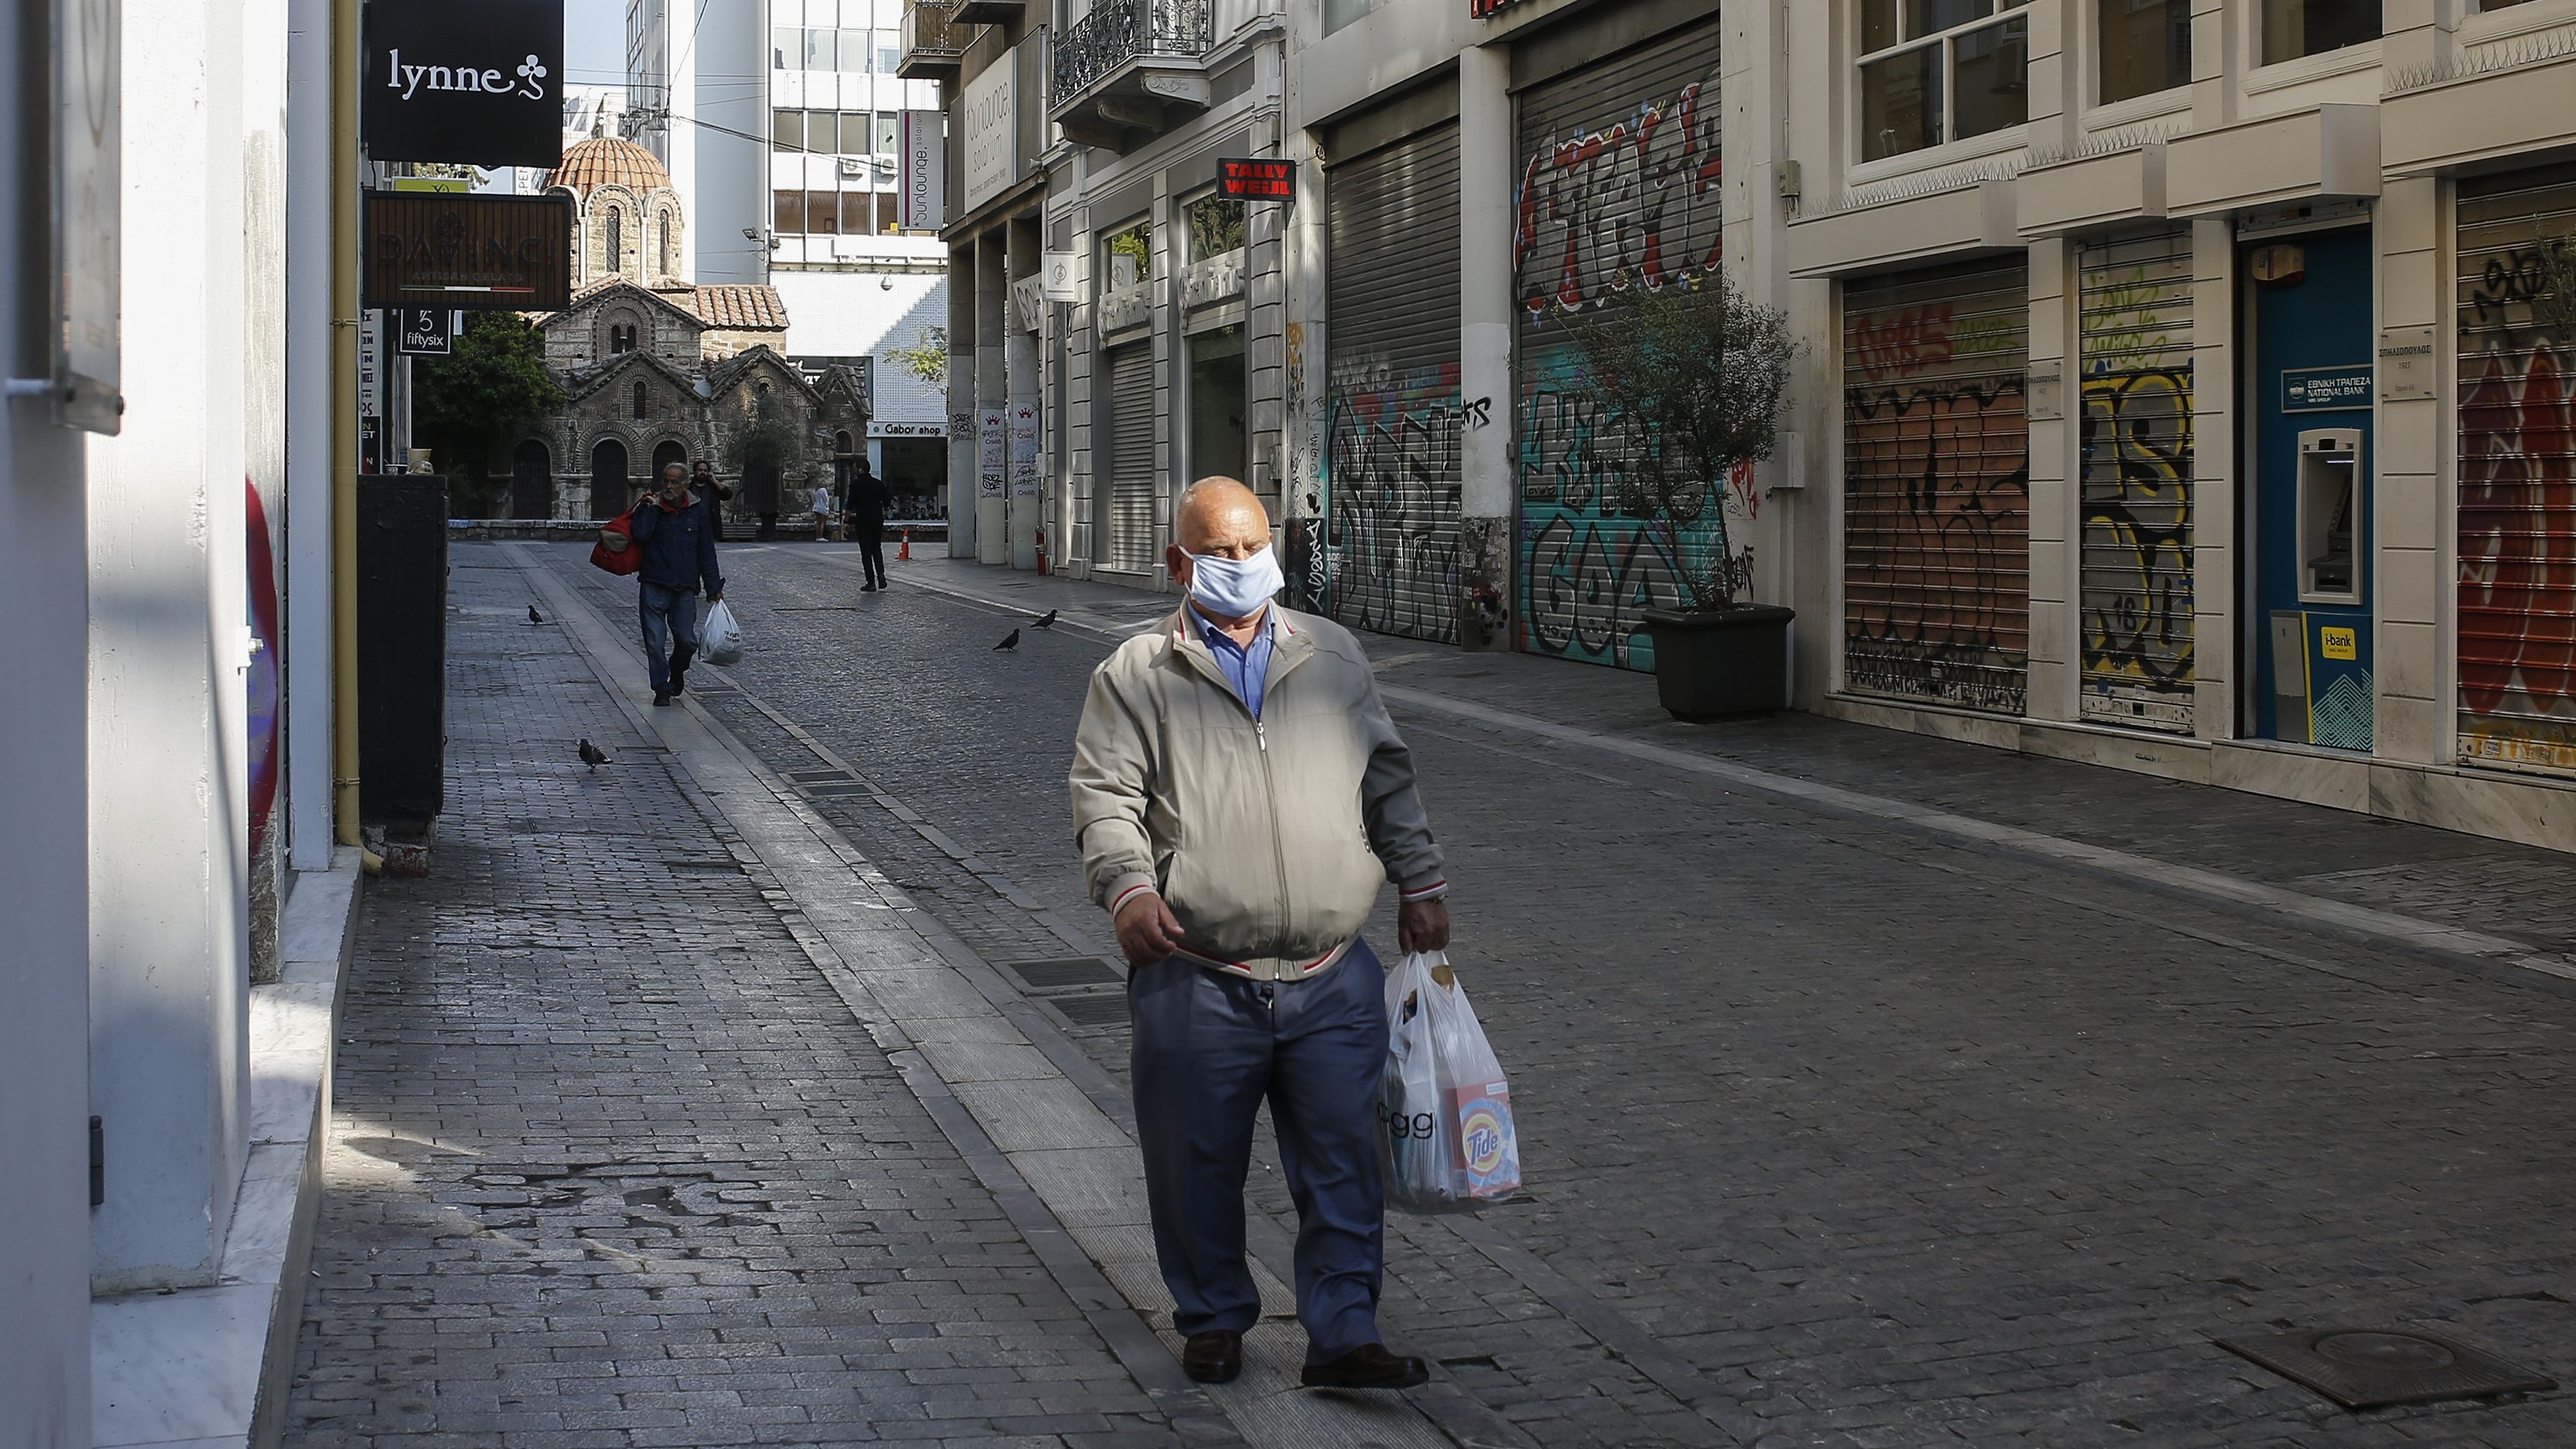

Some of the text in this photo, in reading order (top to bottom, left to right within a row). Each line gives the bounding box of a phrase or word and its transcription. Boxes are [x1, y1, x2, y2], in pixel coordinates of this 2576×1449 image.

[388, 48, 515, 100] lynne
[1224, 163, 1289, 179] TALLY
[472, 272, 523, 283] GELATO
[407, 332, 444, 349] fiftysix
[2307, 377, 2371, 388] ΕΘΝΙΚΗ ΤΡΑΠΕΖΑ
[2307, 387, 2365, 398] NATIONAL BANK
[885, 423, 941, 435] Gabor shop
[2325, 633, 2351, 647] i-bank
[1467, 1127, 1498, 1166] Tide
